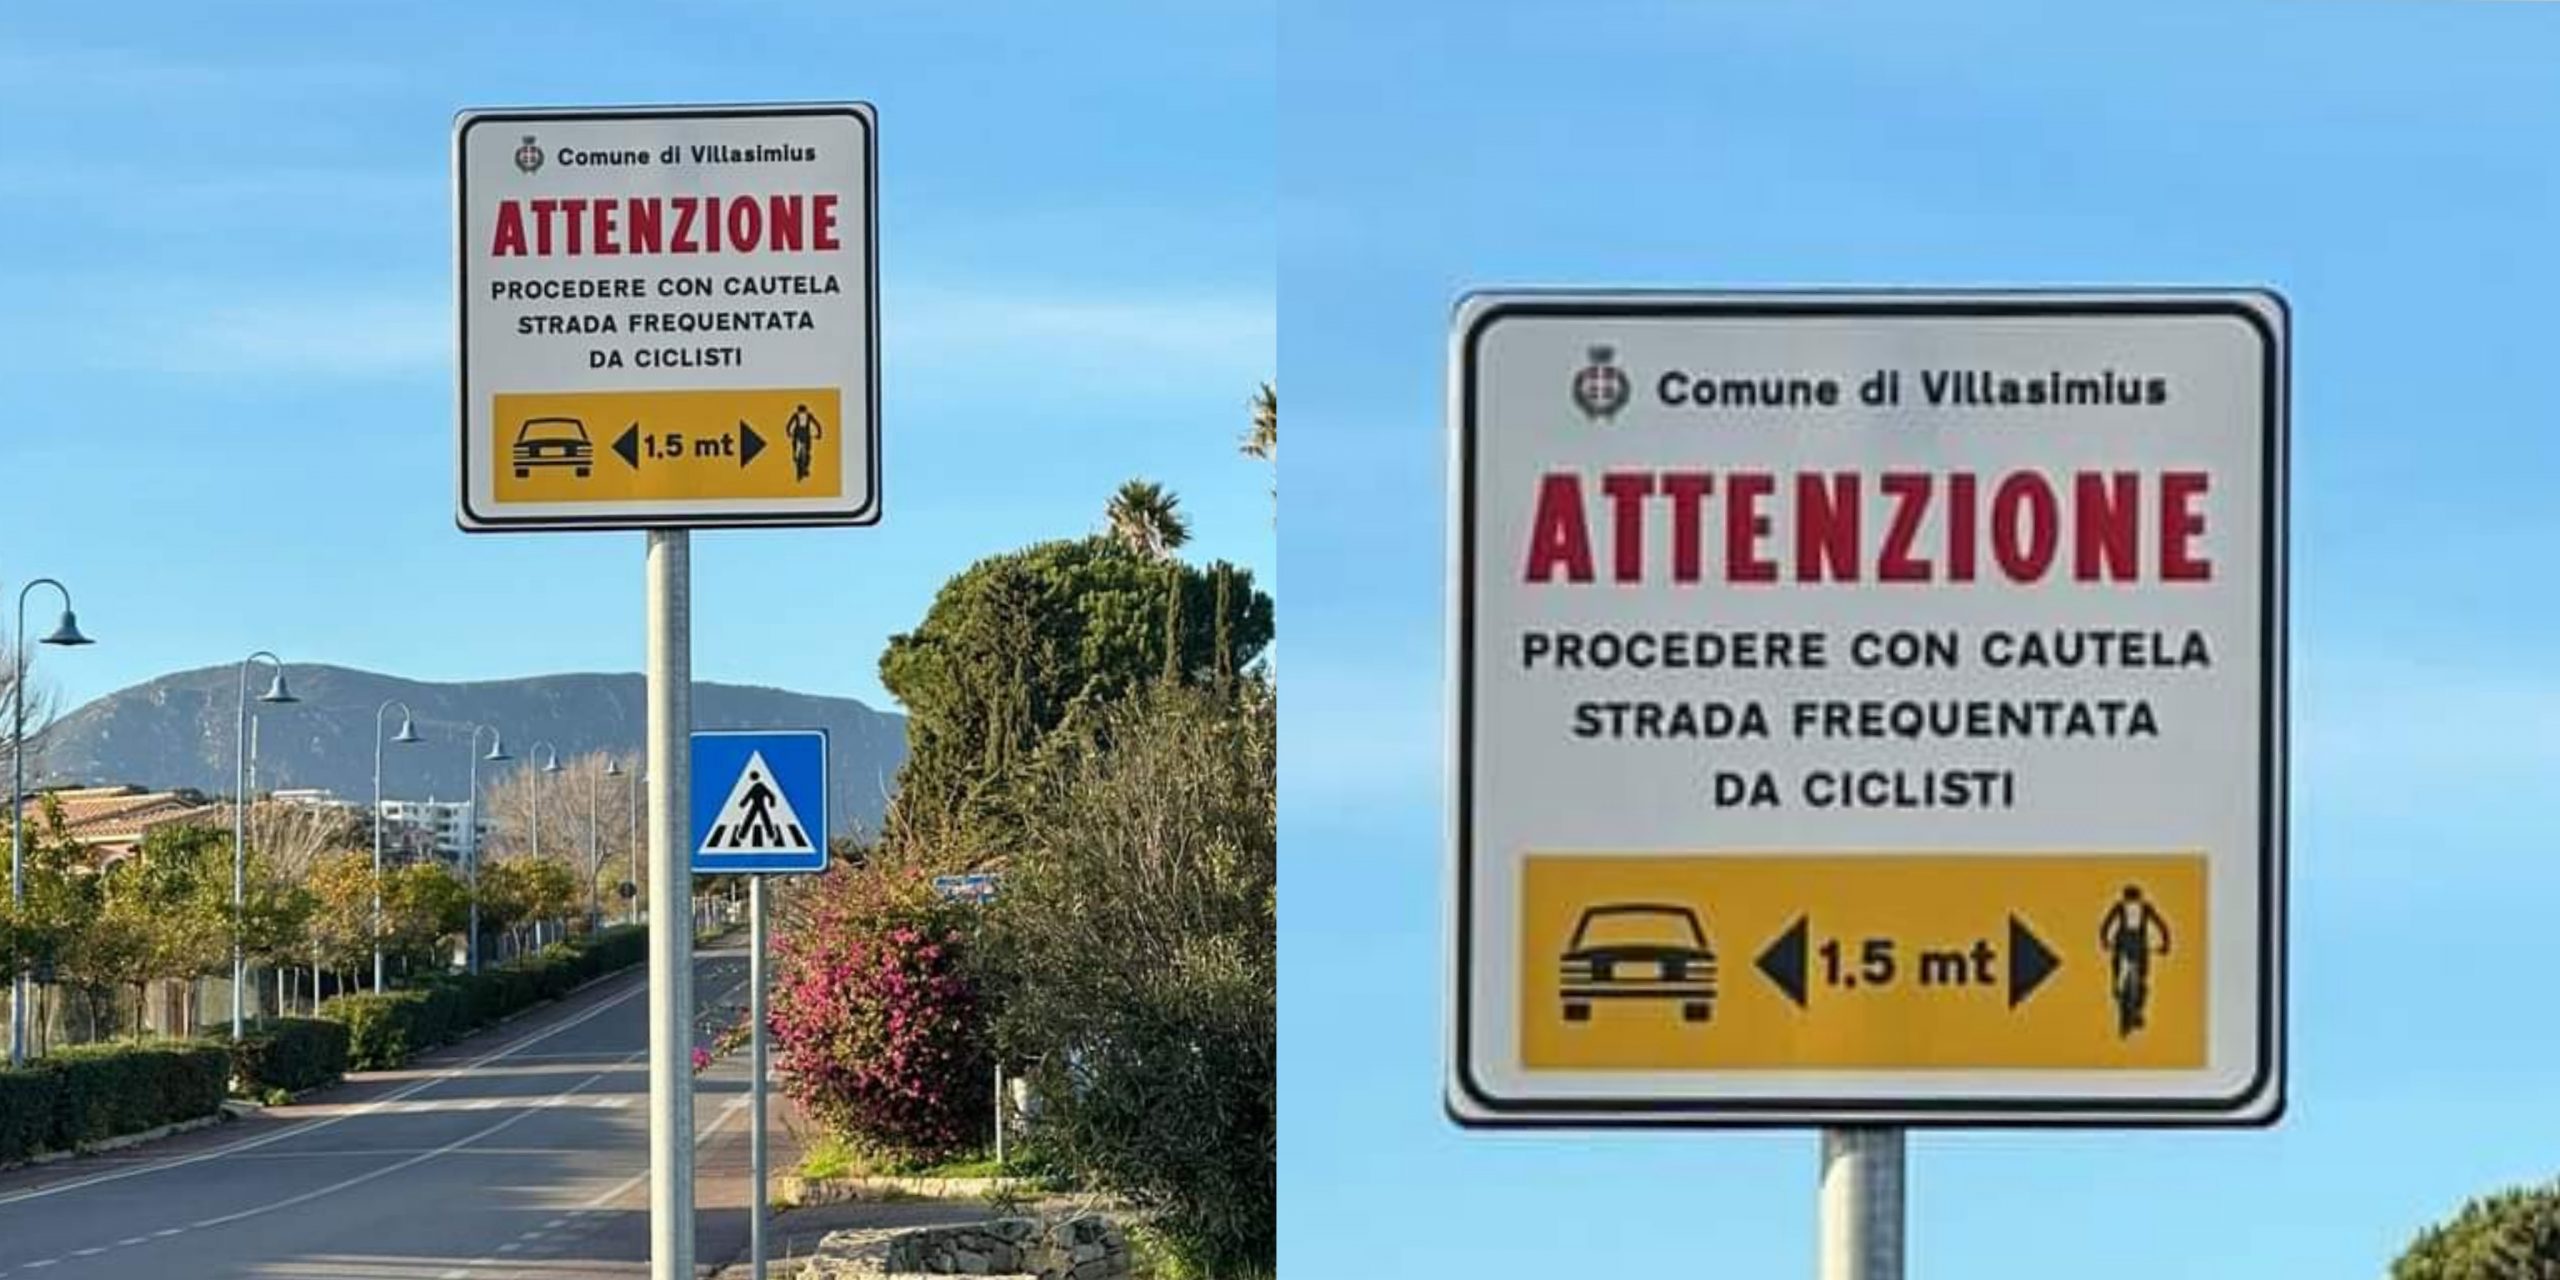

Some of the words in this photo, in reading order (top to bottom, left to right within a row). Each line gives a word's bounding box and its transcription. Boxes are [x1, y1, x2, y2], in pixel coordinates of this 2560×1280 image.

[557, 147, 650, 166] Comune
[660, 145, 681, 165] di
[690, 144, 816, 164] Villasimius
[492, 194, 840, 257] ATTENZIONE
[491, 278, 646, 300] PROCEDERE
[657, 277, 713, 297] CON
[723, 274, 840, 296] CAUTELA
[517, 314, 617, 335] STRADA
[629, 310, 814, 333] FREQUENTATA
[589, 349, 624, 369] DA
[634, 347, 742, 368] CICLISTI
[1657, 370, 1839, 407] Comune
[1859, 369, 1899, 406] di
[1921, 370, 2166, 406] Villasimius
[694, 433, 734, 457] mt
[1524, 471, 2211, 584] ATTENZIONE
[1523, 632, 1827, 669] PROCEDERE
[1850, 631, 1958, 668] CON
[1981, 631, 2210, 668] CAUTELA
[1573, 702, 1769, 738] STRADA
[1793, 701, 2158, 739] FREQUENTATA
[1715, 772, 1780, 807] DA
[1803, 770, 2013, 808] CICLISTI
[1919, 940, 1995, 986] mt
